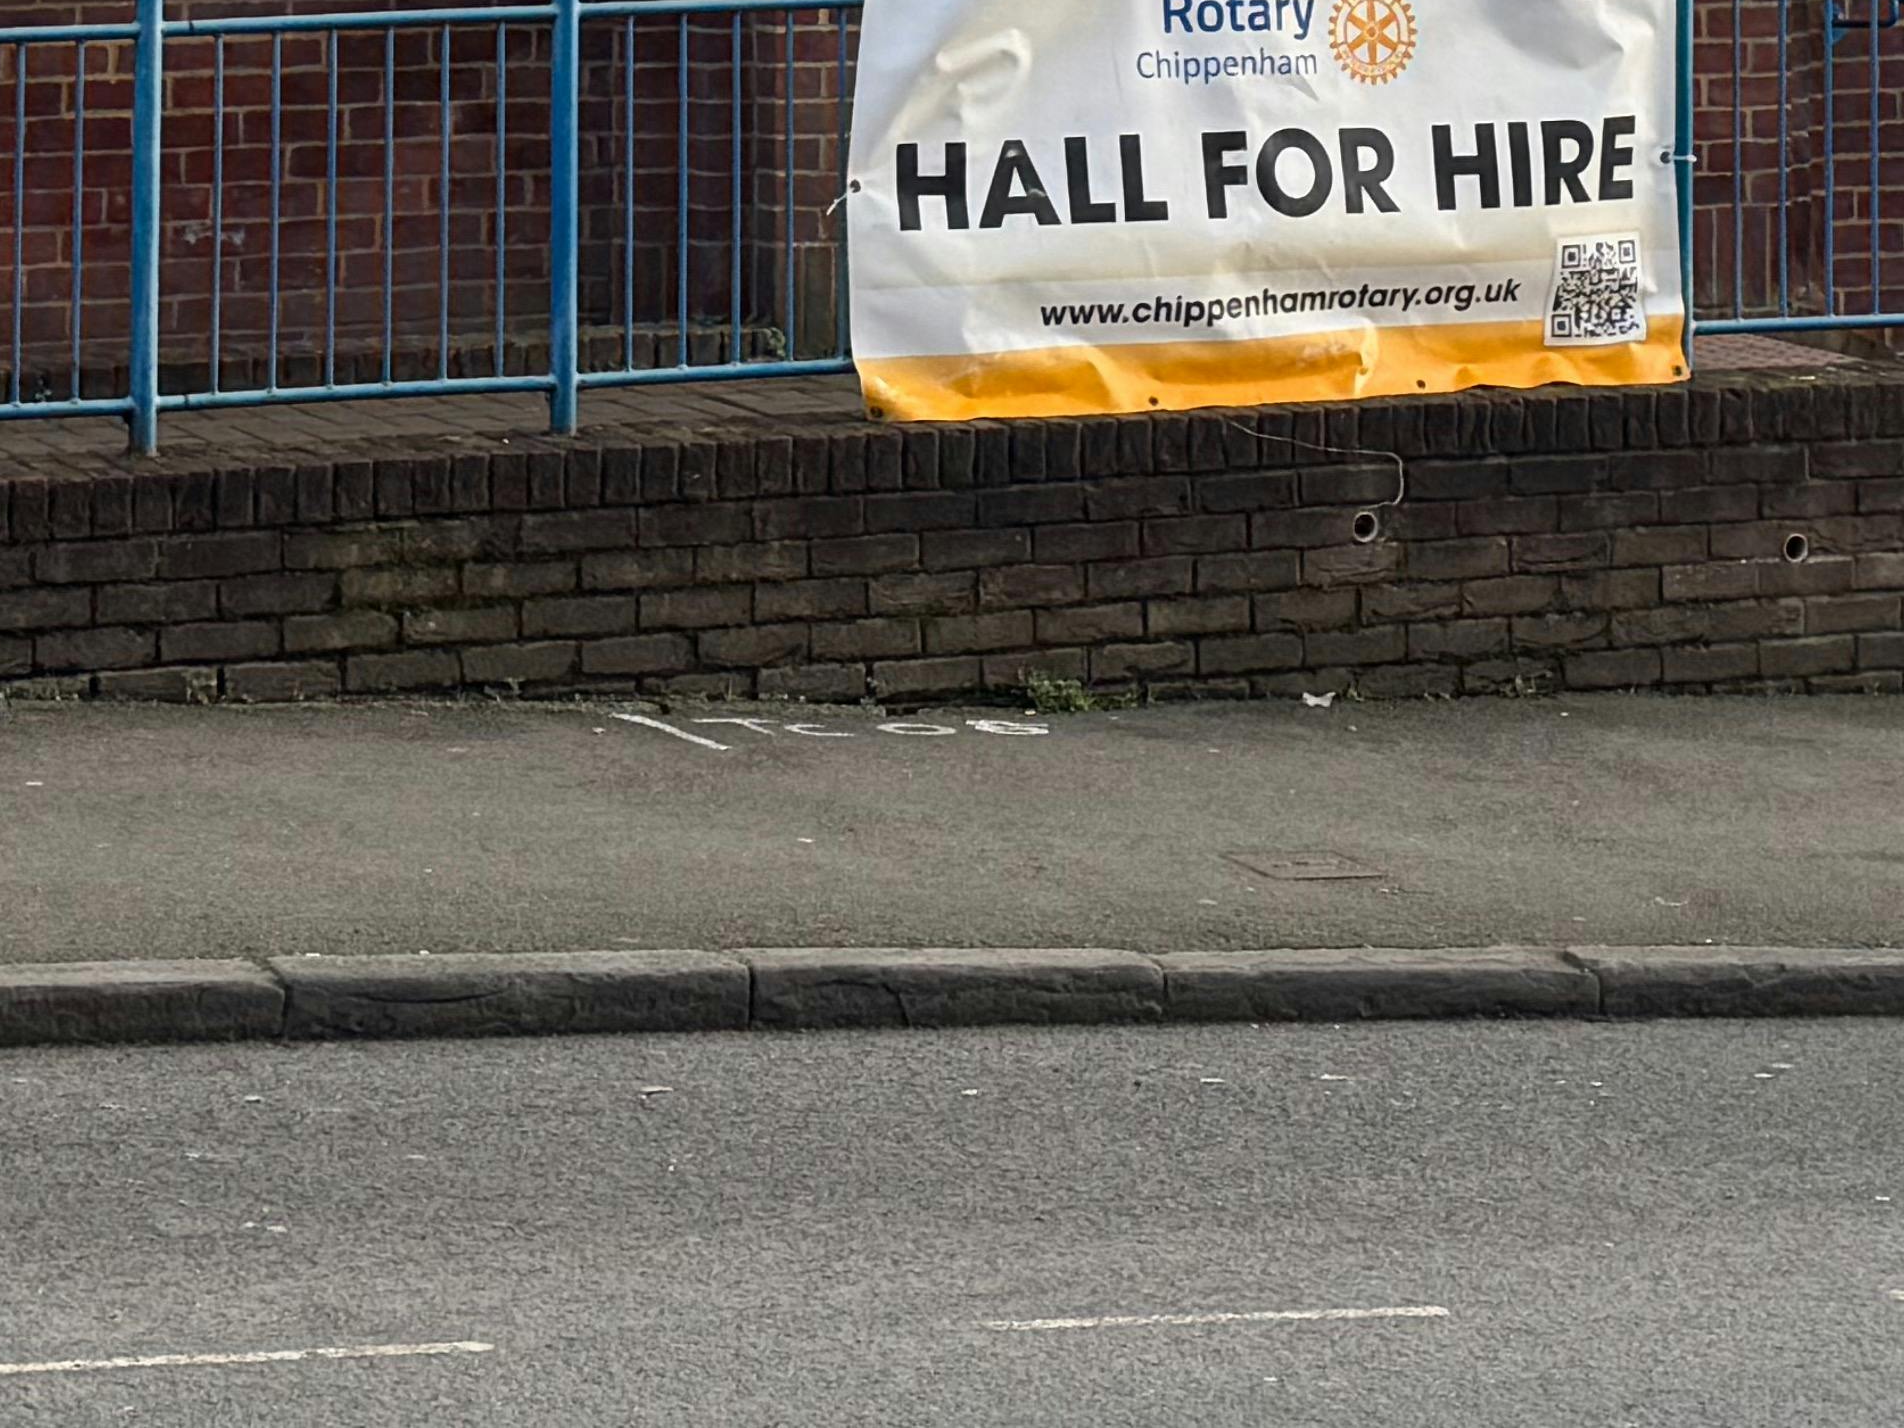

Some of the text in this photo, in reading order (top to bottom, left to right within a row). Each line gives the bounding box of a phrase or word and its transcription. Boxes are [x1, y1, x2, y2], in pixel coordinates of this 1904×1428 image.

[1136, 47, 1317, 85] Chippenham
[897, 115, 1636, 231] HALL FOR HIRE
[1040, 278, 1521, 328] www.chippenhamrotary.org.uk
